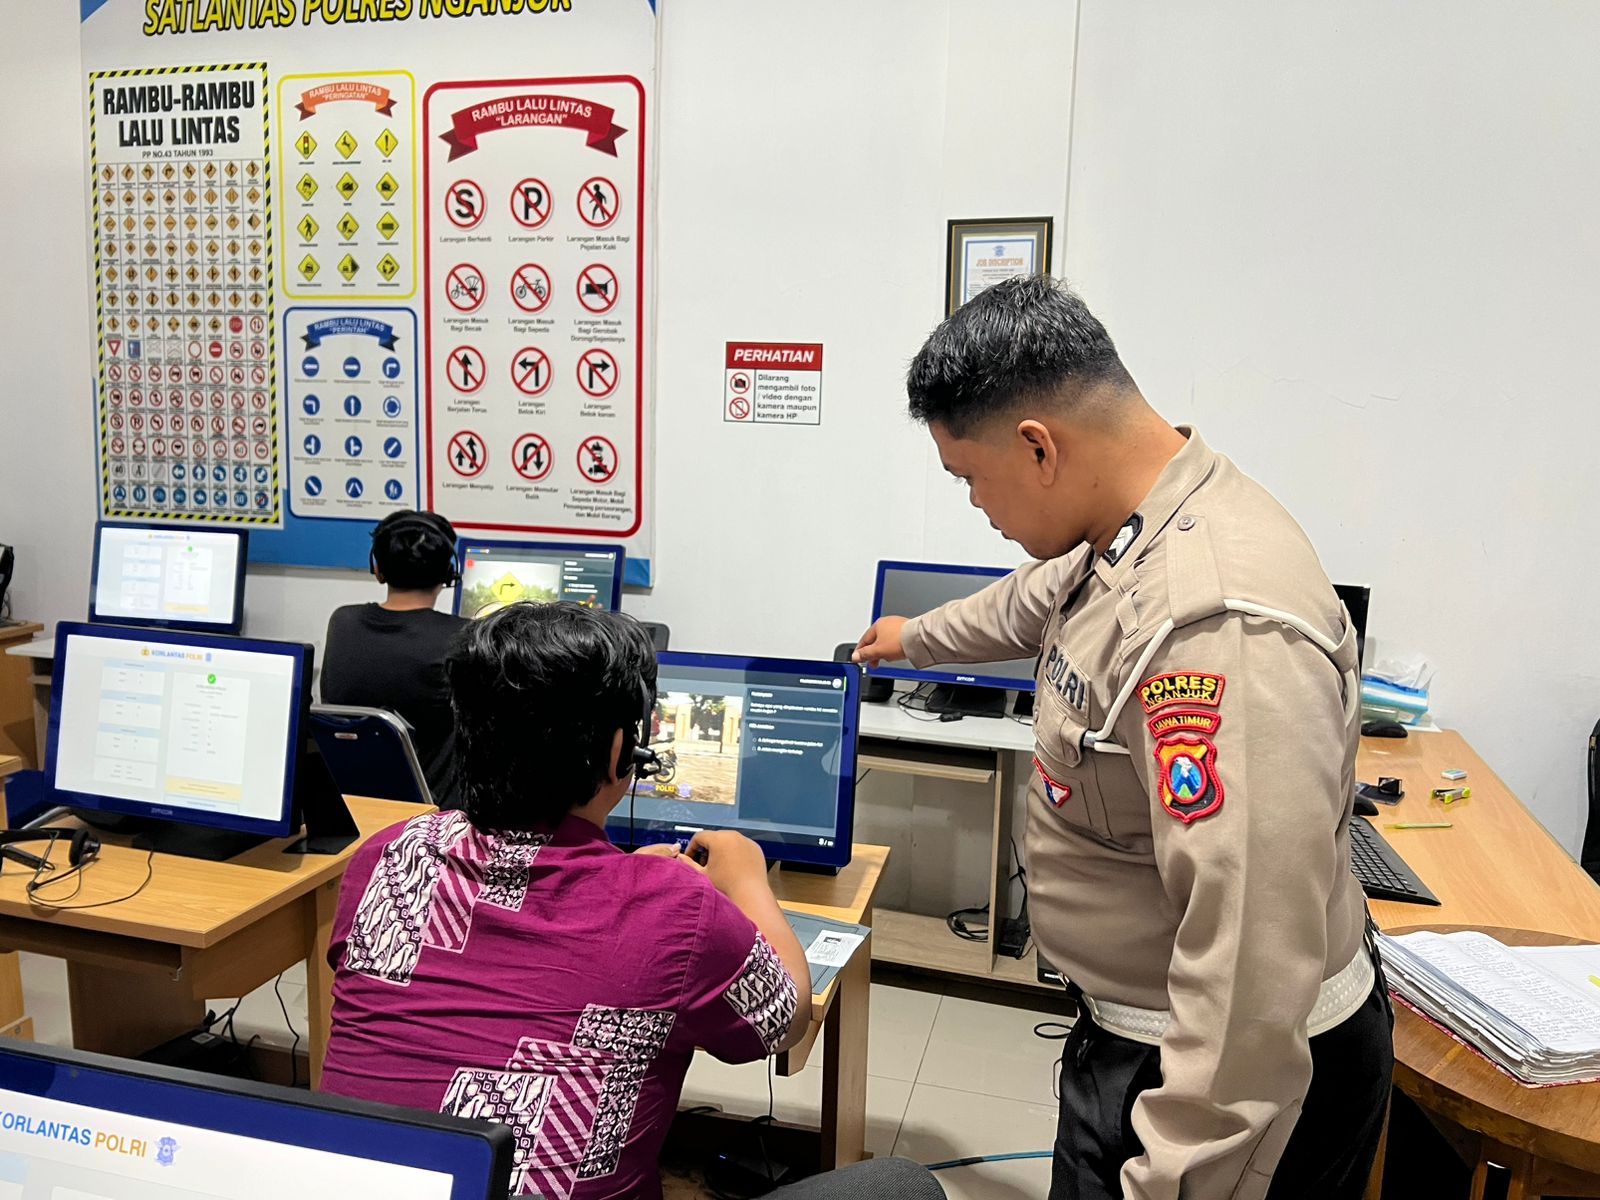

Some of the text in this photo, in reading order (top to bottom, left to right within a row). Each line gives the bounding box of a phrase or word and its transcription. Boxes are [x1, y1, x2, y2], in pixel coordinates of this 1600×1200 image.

[143, 0, 296, 36] SATLANTAS
[309, 83, 382, 99] RAMBU LALU LINTAS
[103, 80, 255, 115] RAMBU-RAMBU
[471, 98, 592, 122] RAMBU LALU LINTAS
[118, 115, 240, 147] LALU LINTAS
[440, 235, 467, 243] Larangan
[508, 235, 535, 243] Larangan
[566, 235, 594, 243] Larangan
[508, 317, 535, 325] Larangan
[733, 348, 815, 363] PERHATIAN
[758, 374, 790, 383] Dilarang
[757, 384, 816, 392] mengambil foto
[784, 394, 813, 402] dengan
[518, 400, 545, 408] Larangan
[583, 402, 612, 410] Larangan
[757, 402, 817, 412] kamera maupun
[757, 411, 798, 420] kamera HP
[442, 481, 469, 489] Larangan
[506, 484, 533, 492] Larangan
[570, 487, 594, 495] Larangan
[1045, 642, 1085, 710] POLRI
[1140, 675, 1218, 699] POLRES
[1145, 688, 1213, 707] NGANJUK
[94, 1131, 148, 1158] POLRI
